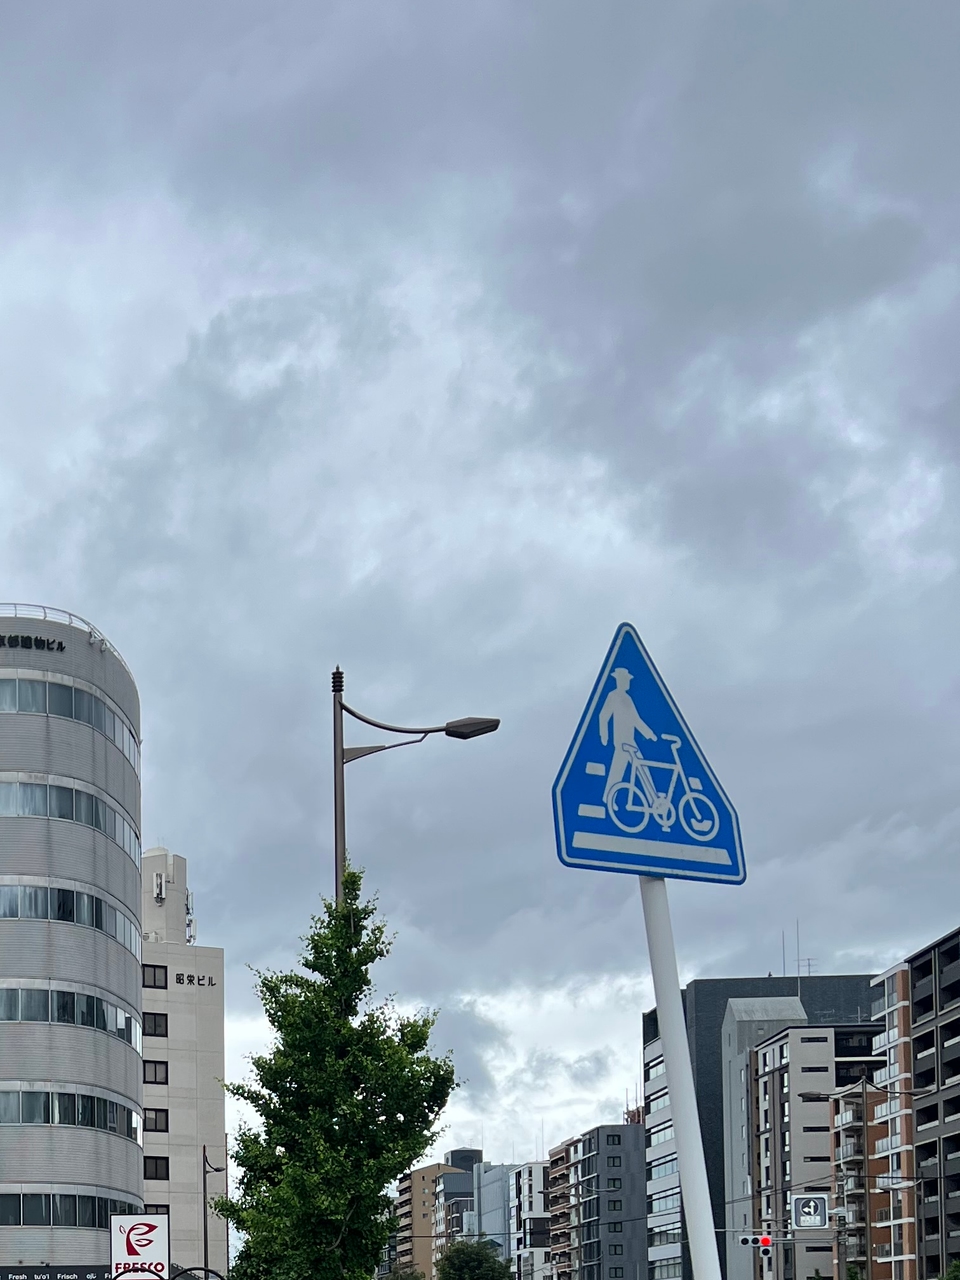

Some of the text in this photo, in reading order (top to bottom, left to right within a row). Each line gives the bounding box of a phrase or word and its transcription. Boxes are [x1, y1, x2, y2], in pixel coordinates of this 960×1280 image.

[175, 973, 217, 986] 昭栄ビル
[114, 1262, 165, 1273] FRESCO
